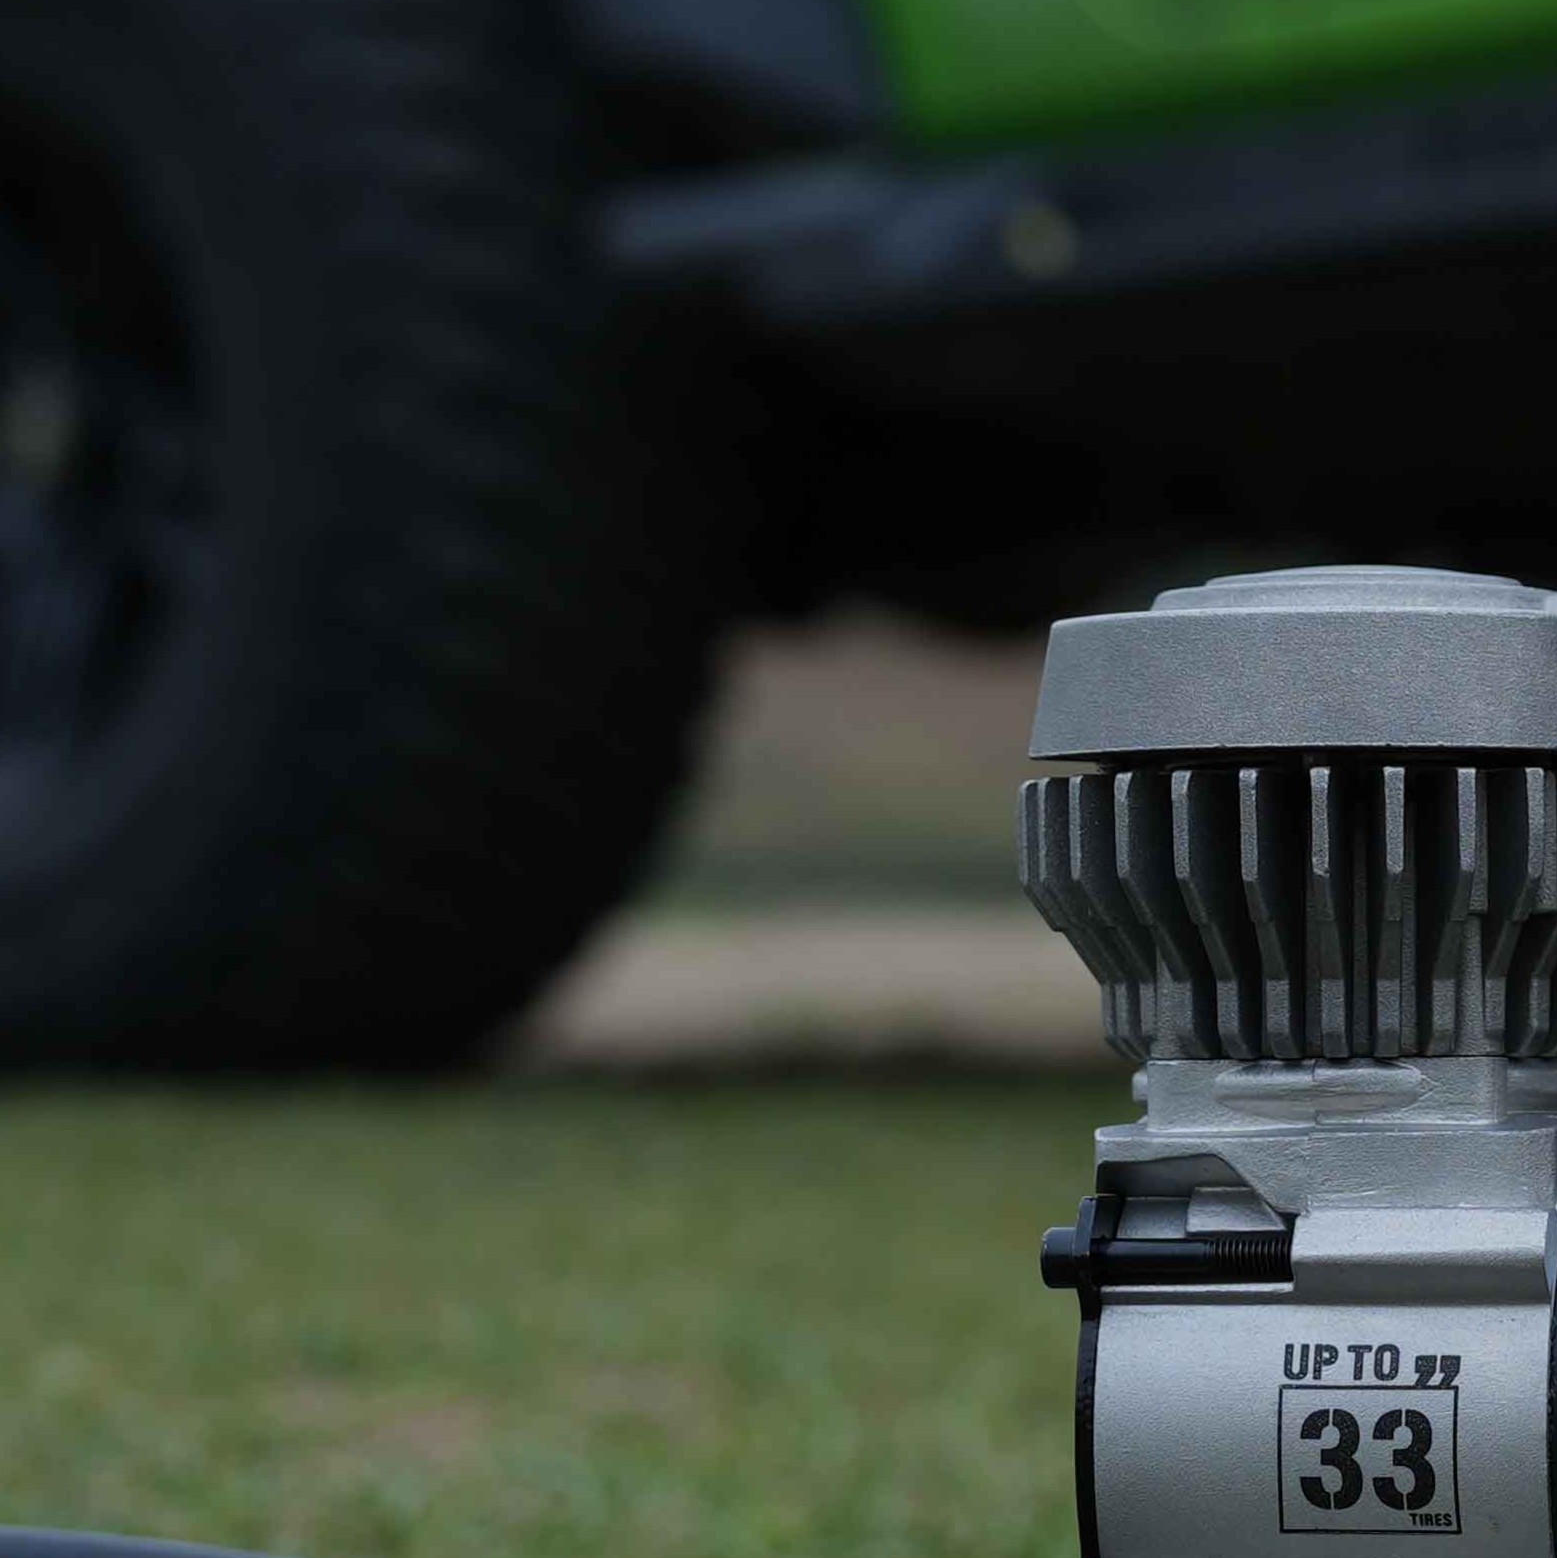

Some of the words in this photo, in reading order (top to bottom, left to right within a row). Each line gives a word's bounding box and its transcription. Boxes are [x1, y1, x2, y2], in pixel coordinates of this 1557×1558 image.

[1283, 1343, 1339, 1380] UP
[1347, 1343, 1401, 1381] TO
[1300, 1408, 1436, 1511] 33
[1409, 1513, 1452, 1527] TIRES
